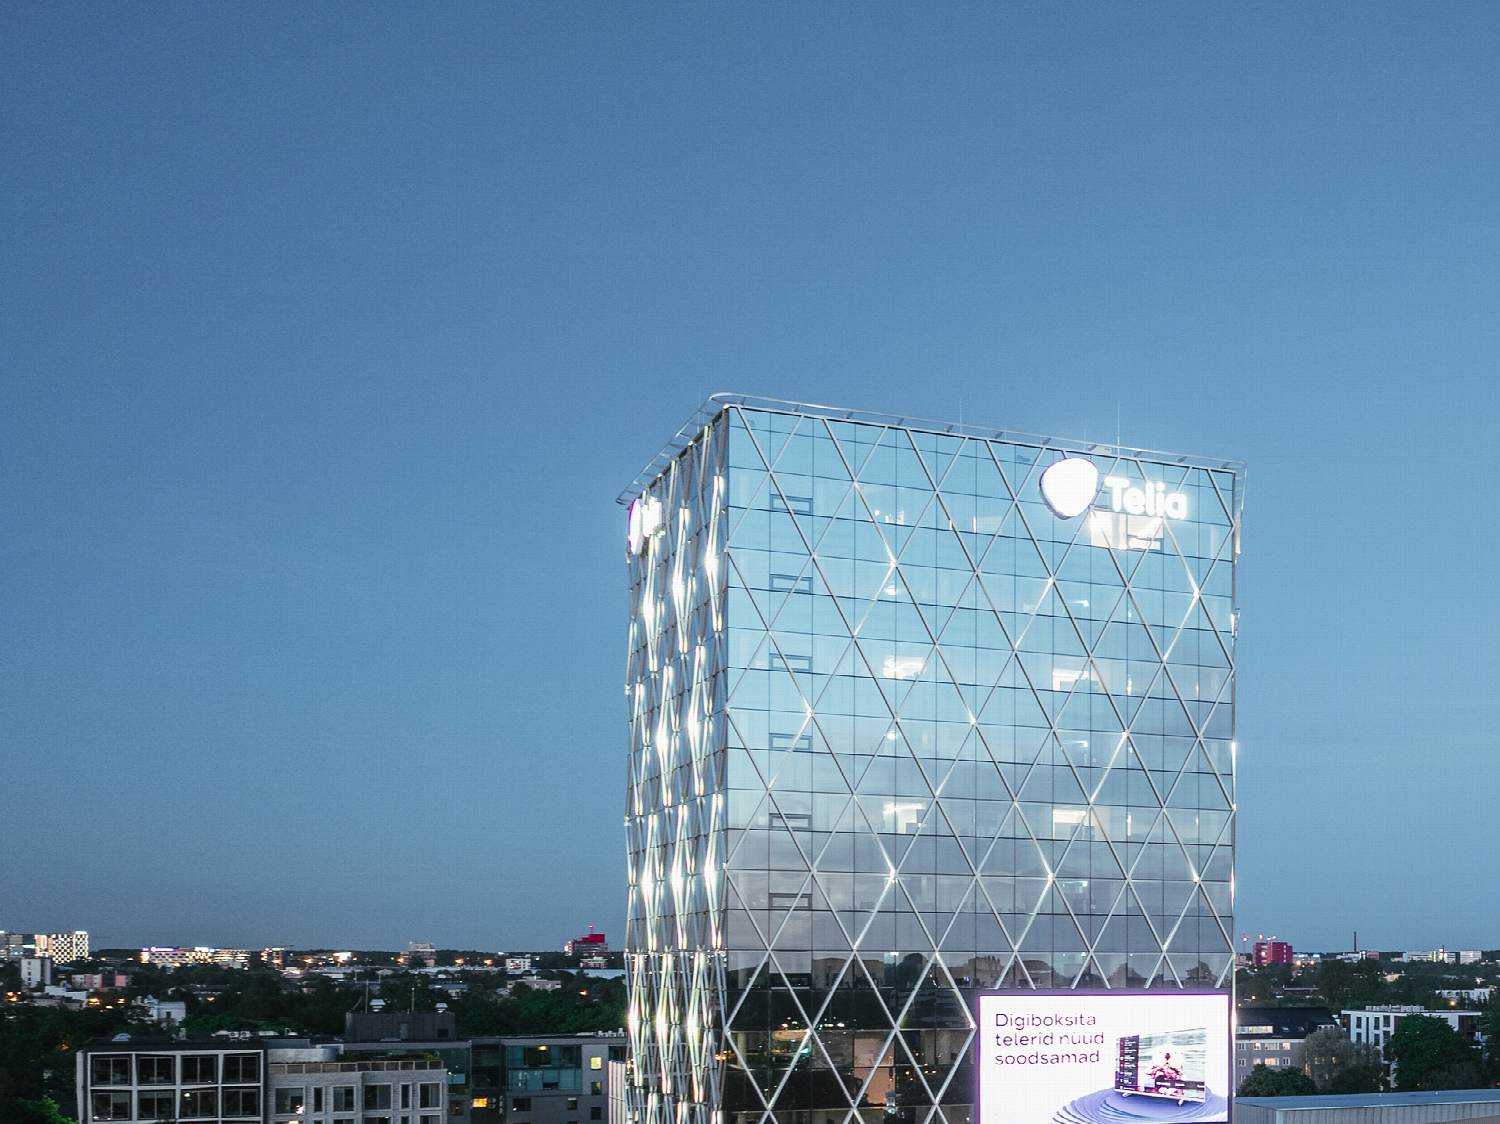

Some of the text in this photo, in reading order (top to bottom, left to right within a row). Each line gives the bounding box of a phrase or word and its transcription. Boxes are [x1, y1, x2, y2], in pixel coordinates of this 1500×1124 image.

[1104, 476, 1187, 519] Telia
[995, 1013, 1096, 1030] Digiboksita
[995, 1032, 1104, 1046] telerid nüüd
[995, 1050, 1100, 1065] soodsamad
